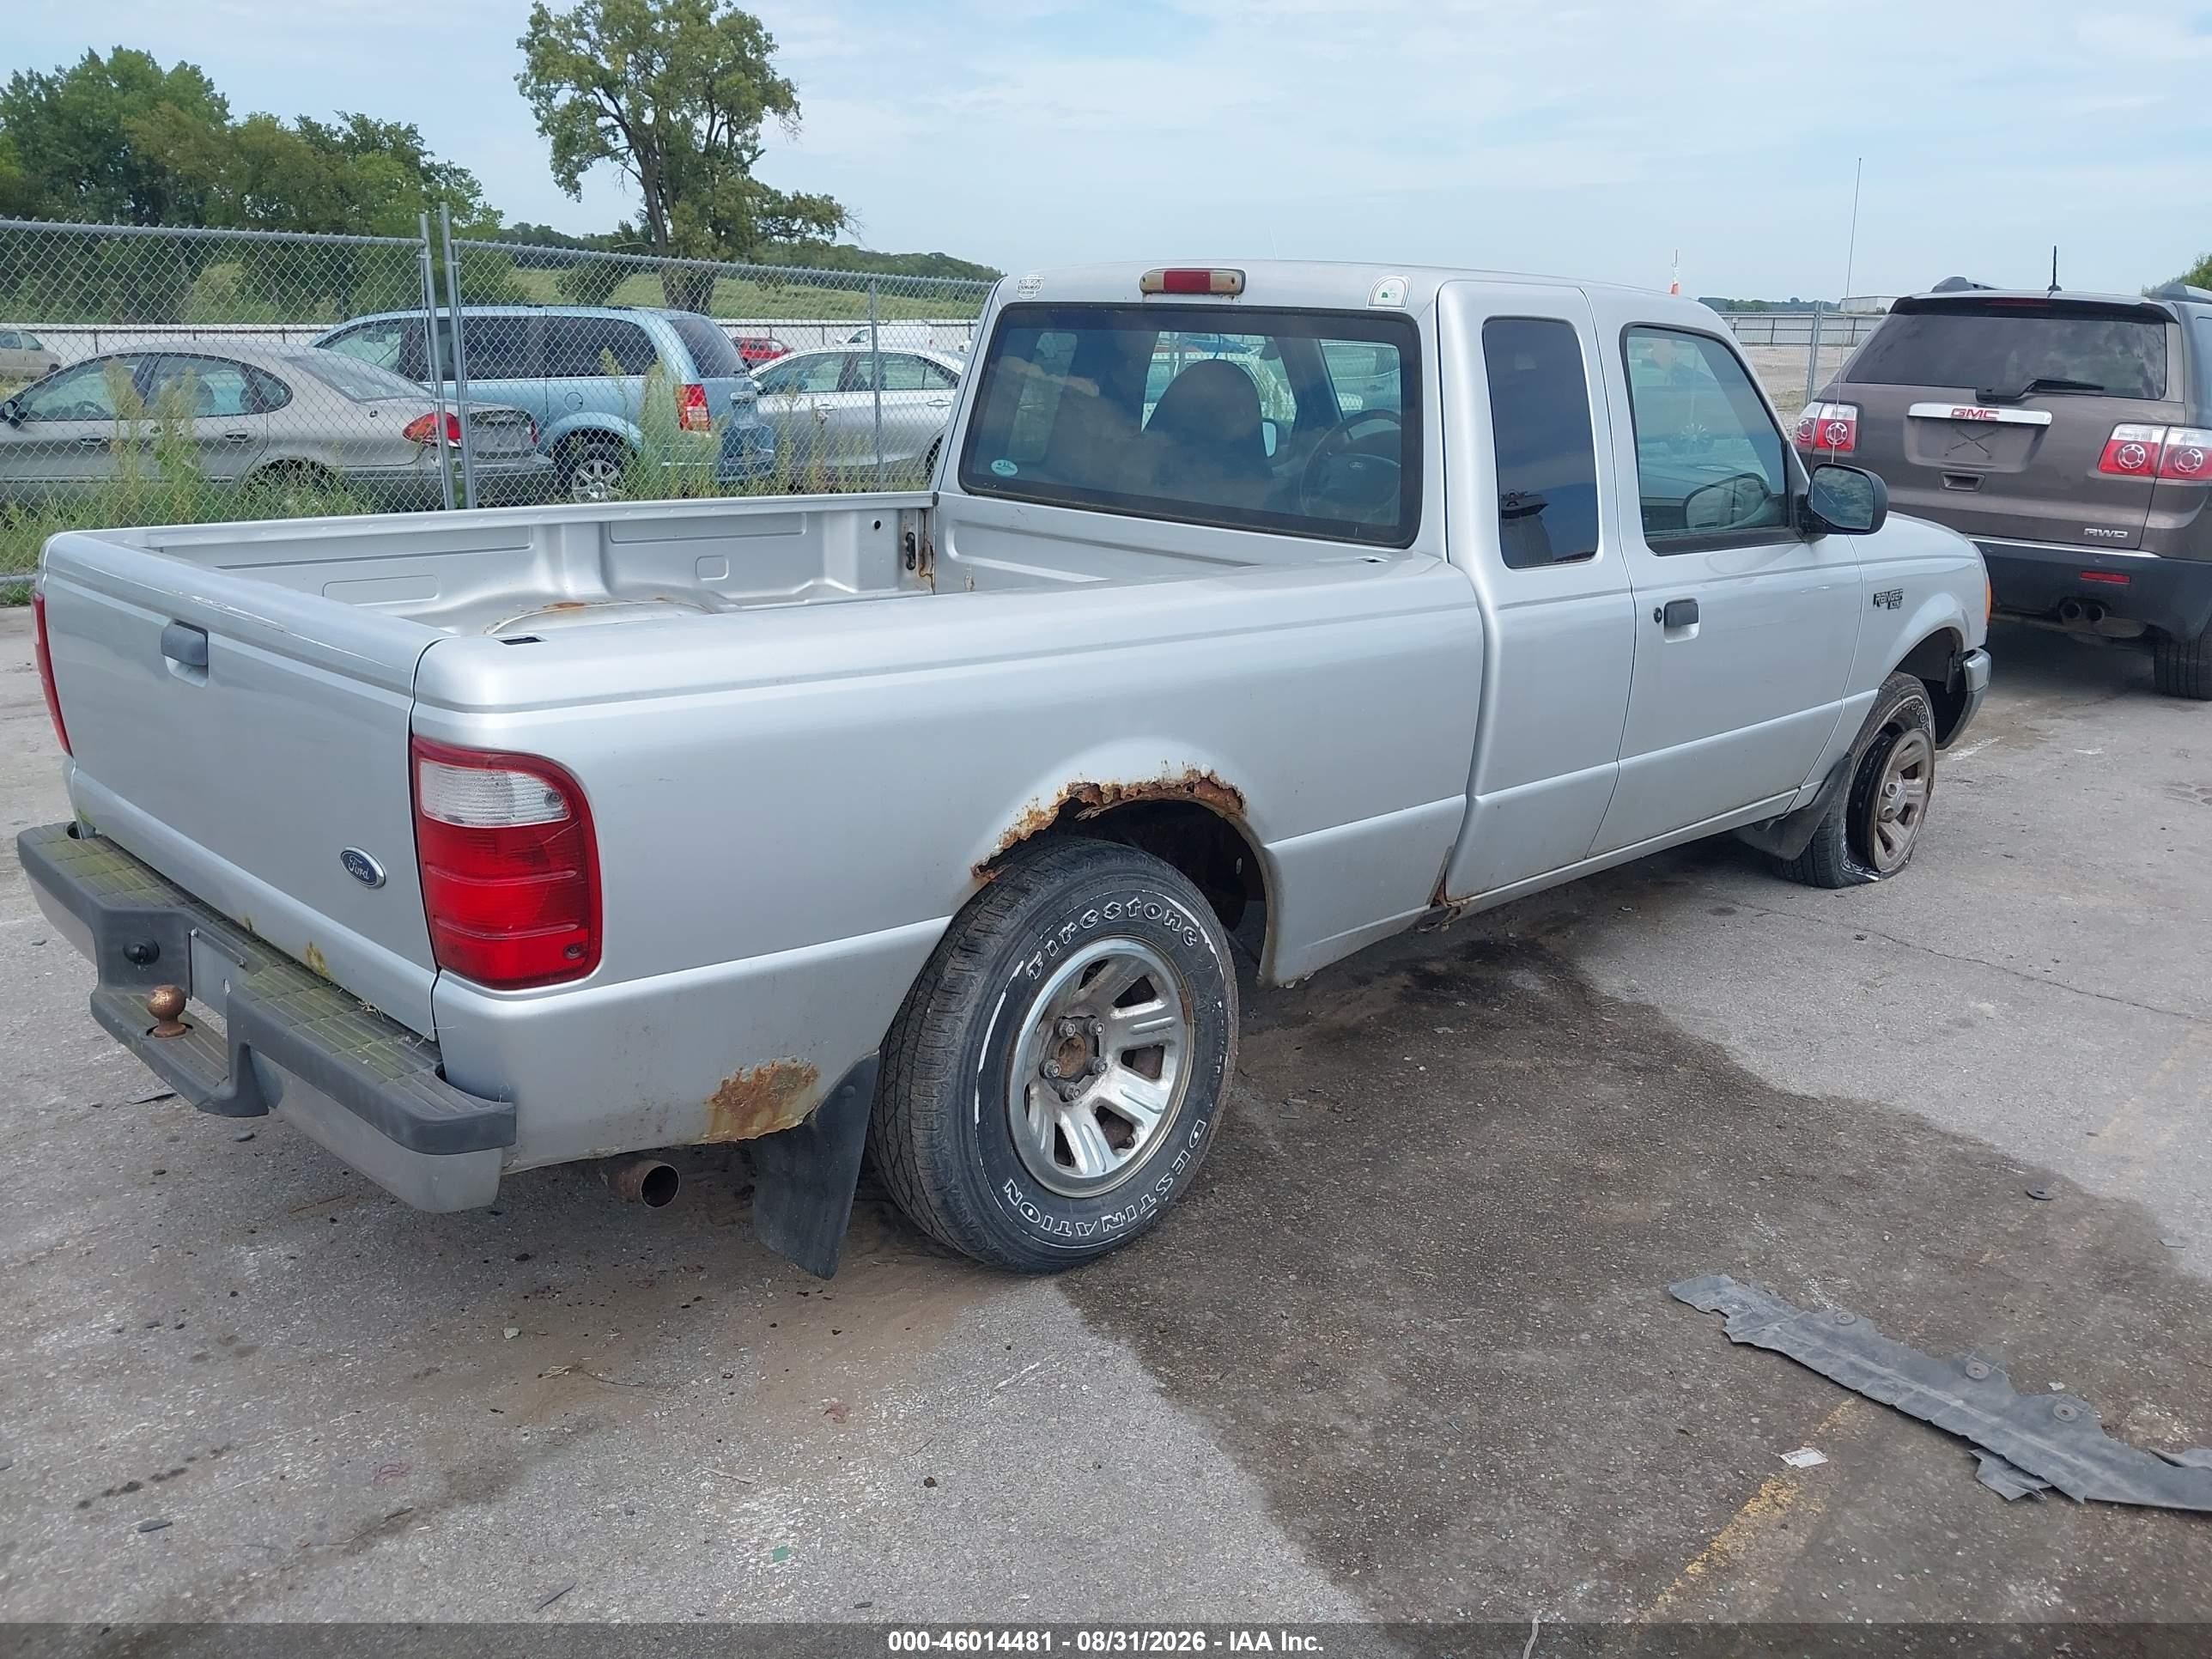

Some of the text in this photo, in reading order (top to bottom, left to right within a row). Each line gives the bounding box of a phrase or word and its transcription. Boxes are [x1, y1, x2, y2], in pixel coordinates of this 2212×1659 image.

[1951, 408, 1999, 420] GMC
[2084, 528, 2128, 538] AWD
[1873, 588, 1903, 607] RANGER
[348, 855, 369, 879] Ford
[1004, 1120, 1206, 1237] DESTINATION
